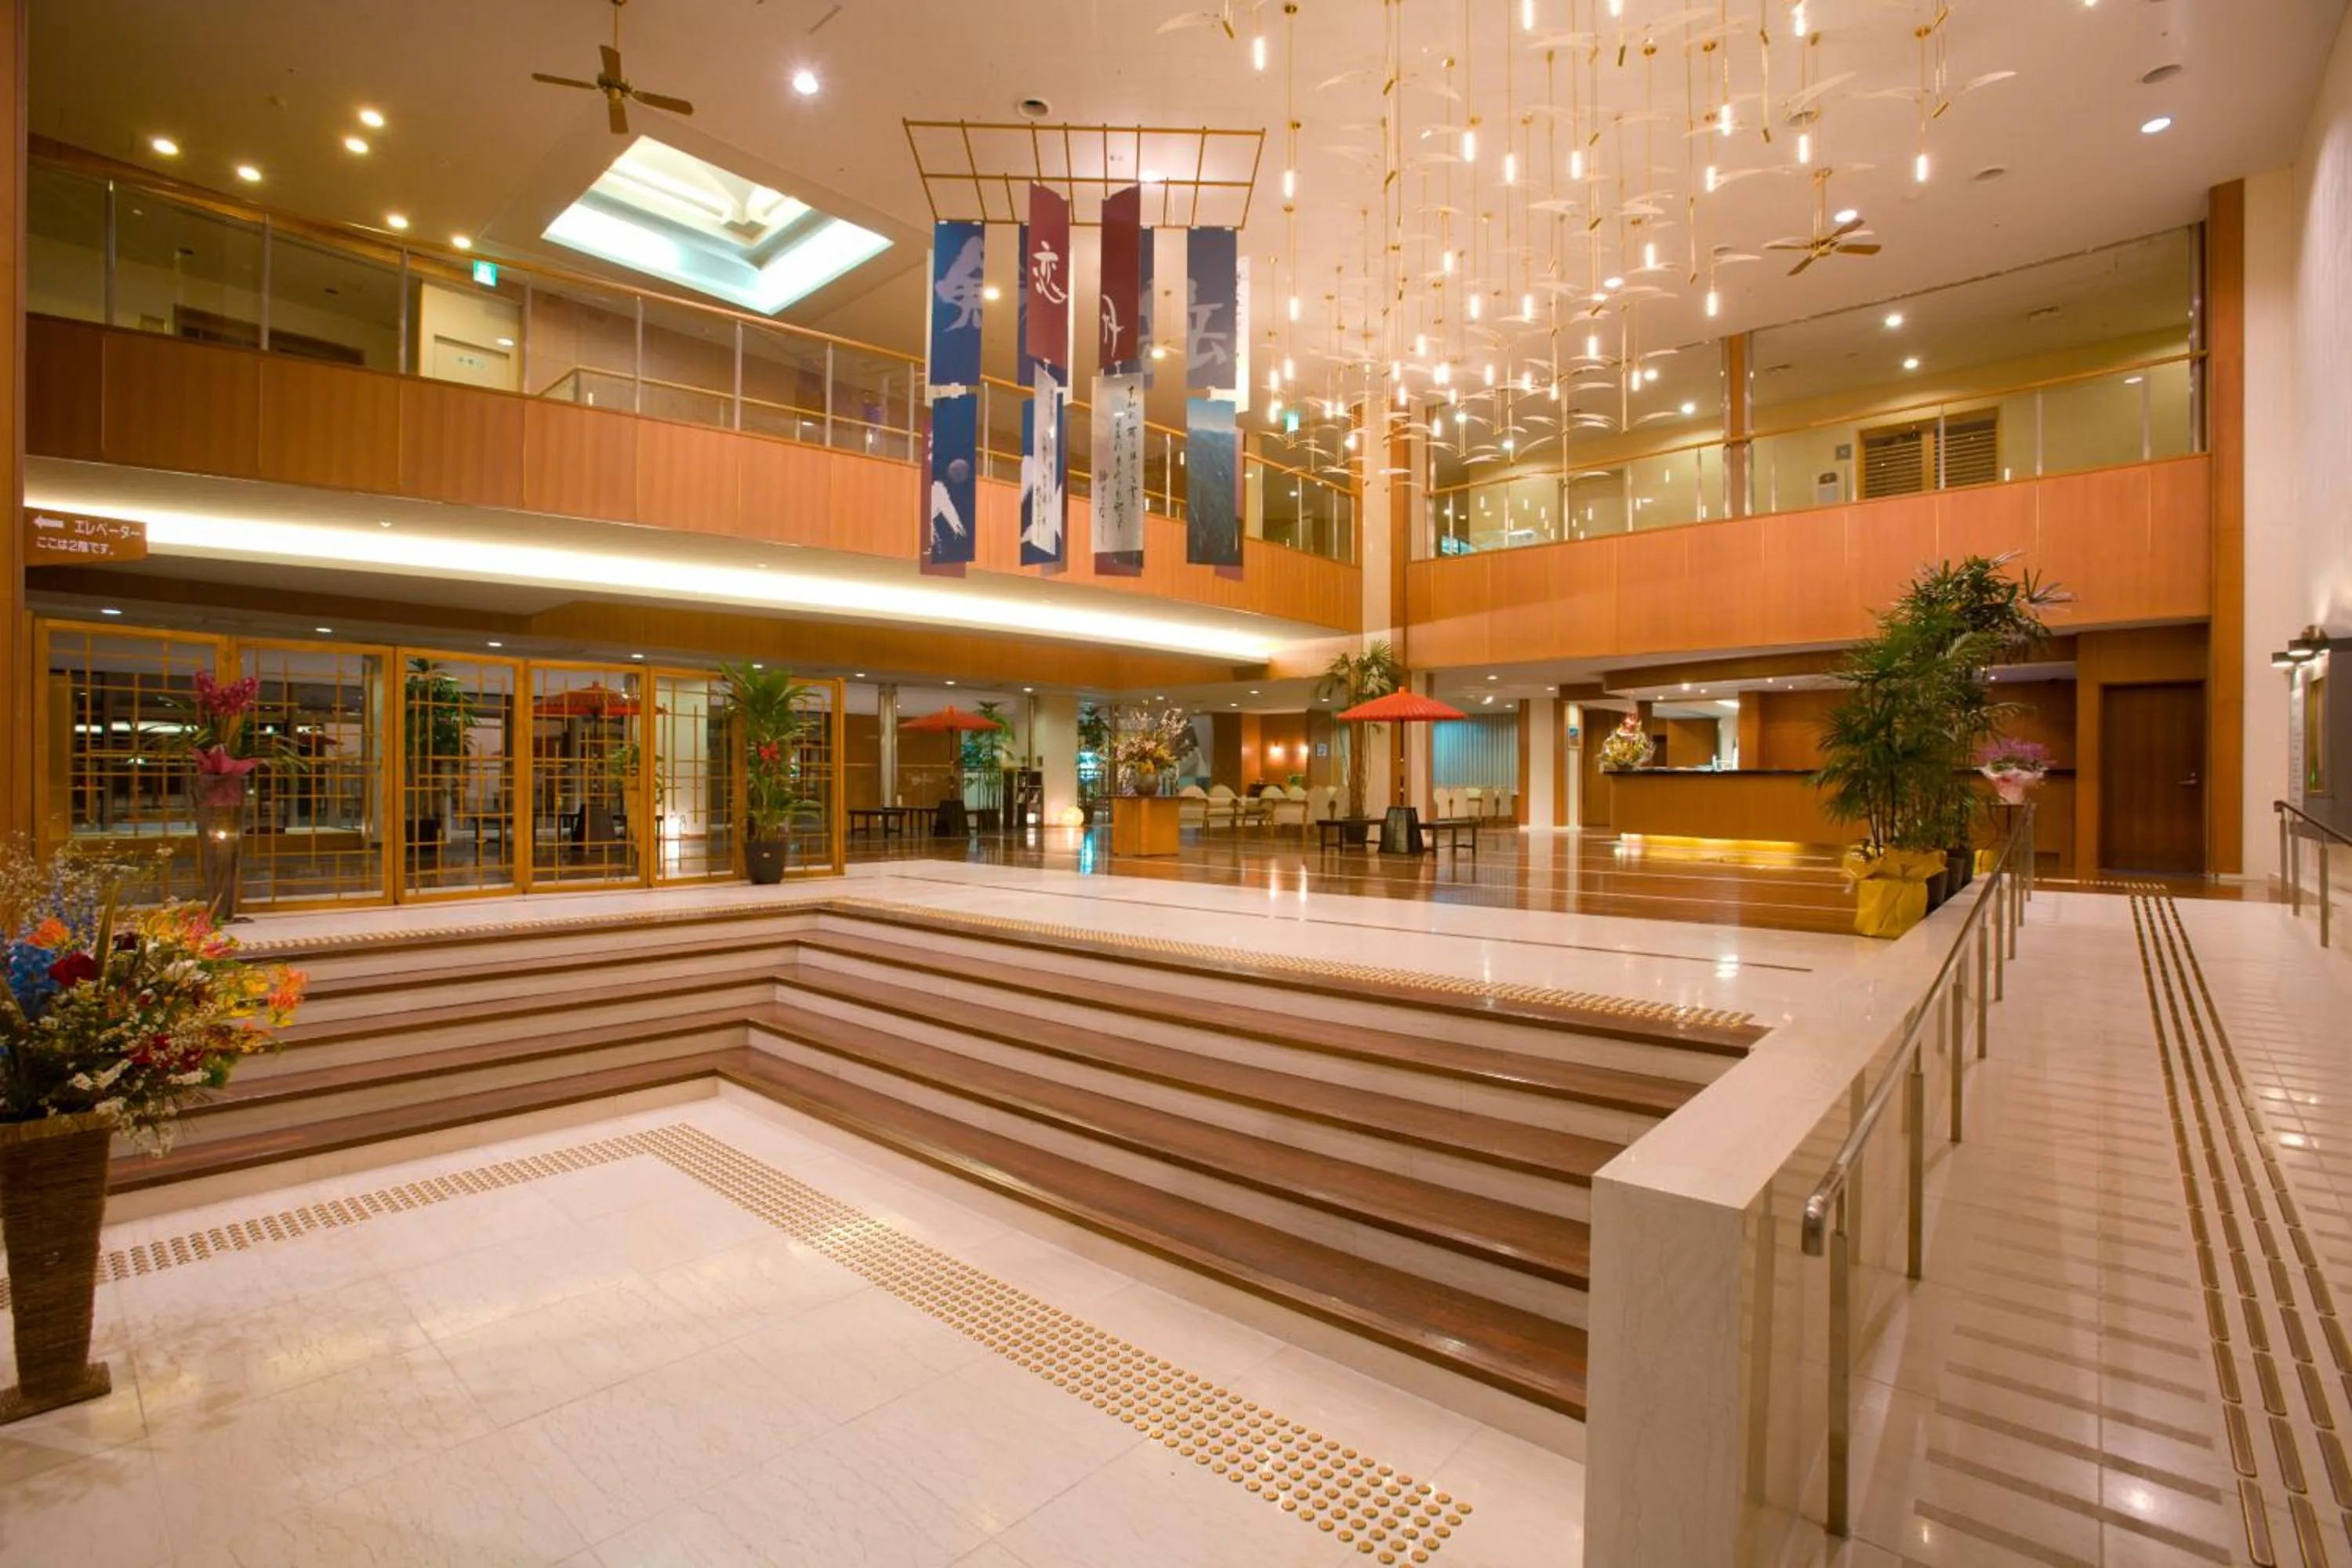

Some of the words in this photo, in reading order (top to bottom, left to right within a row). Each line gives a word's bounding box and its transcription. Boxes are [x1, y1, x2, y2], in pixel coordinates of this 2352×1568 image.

[74, 519, 141, 539] エレベーター
